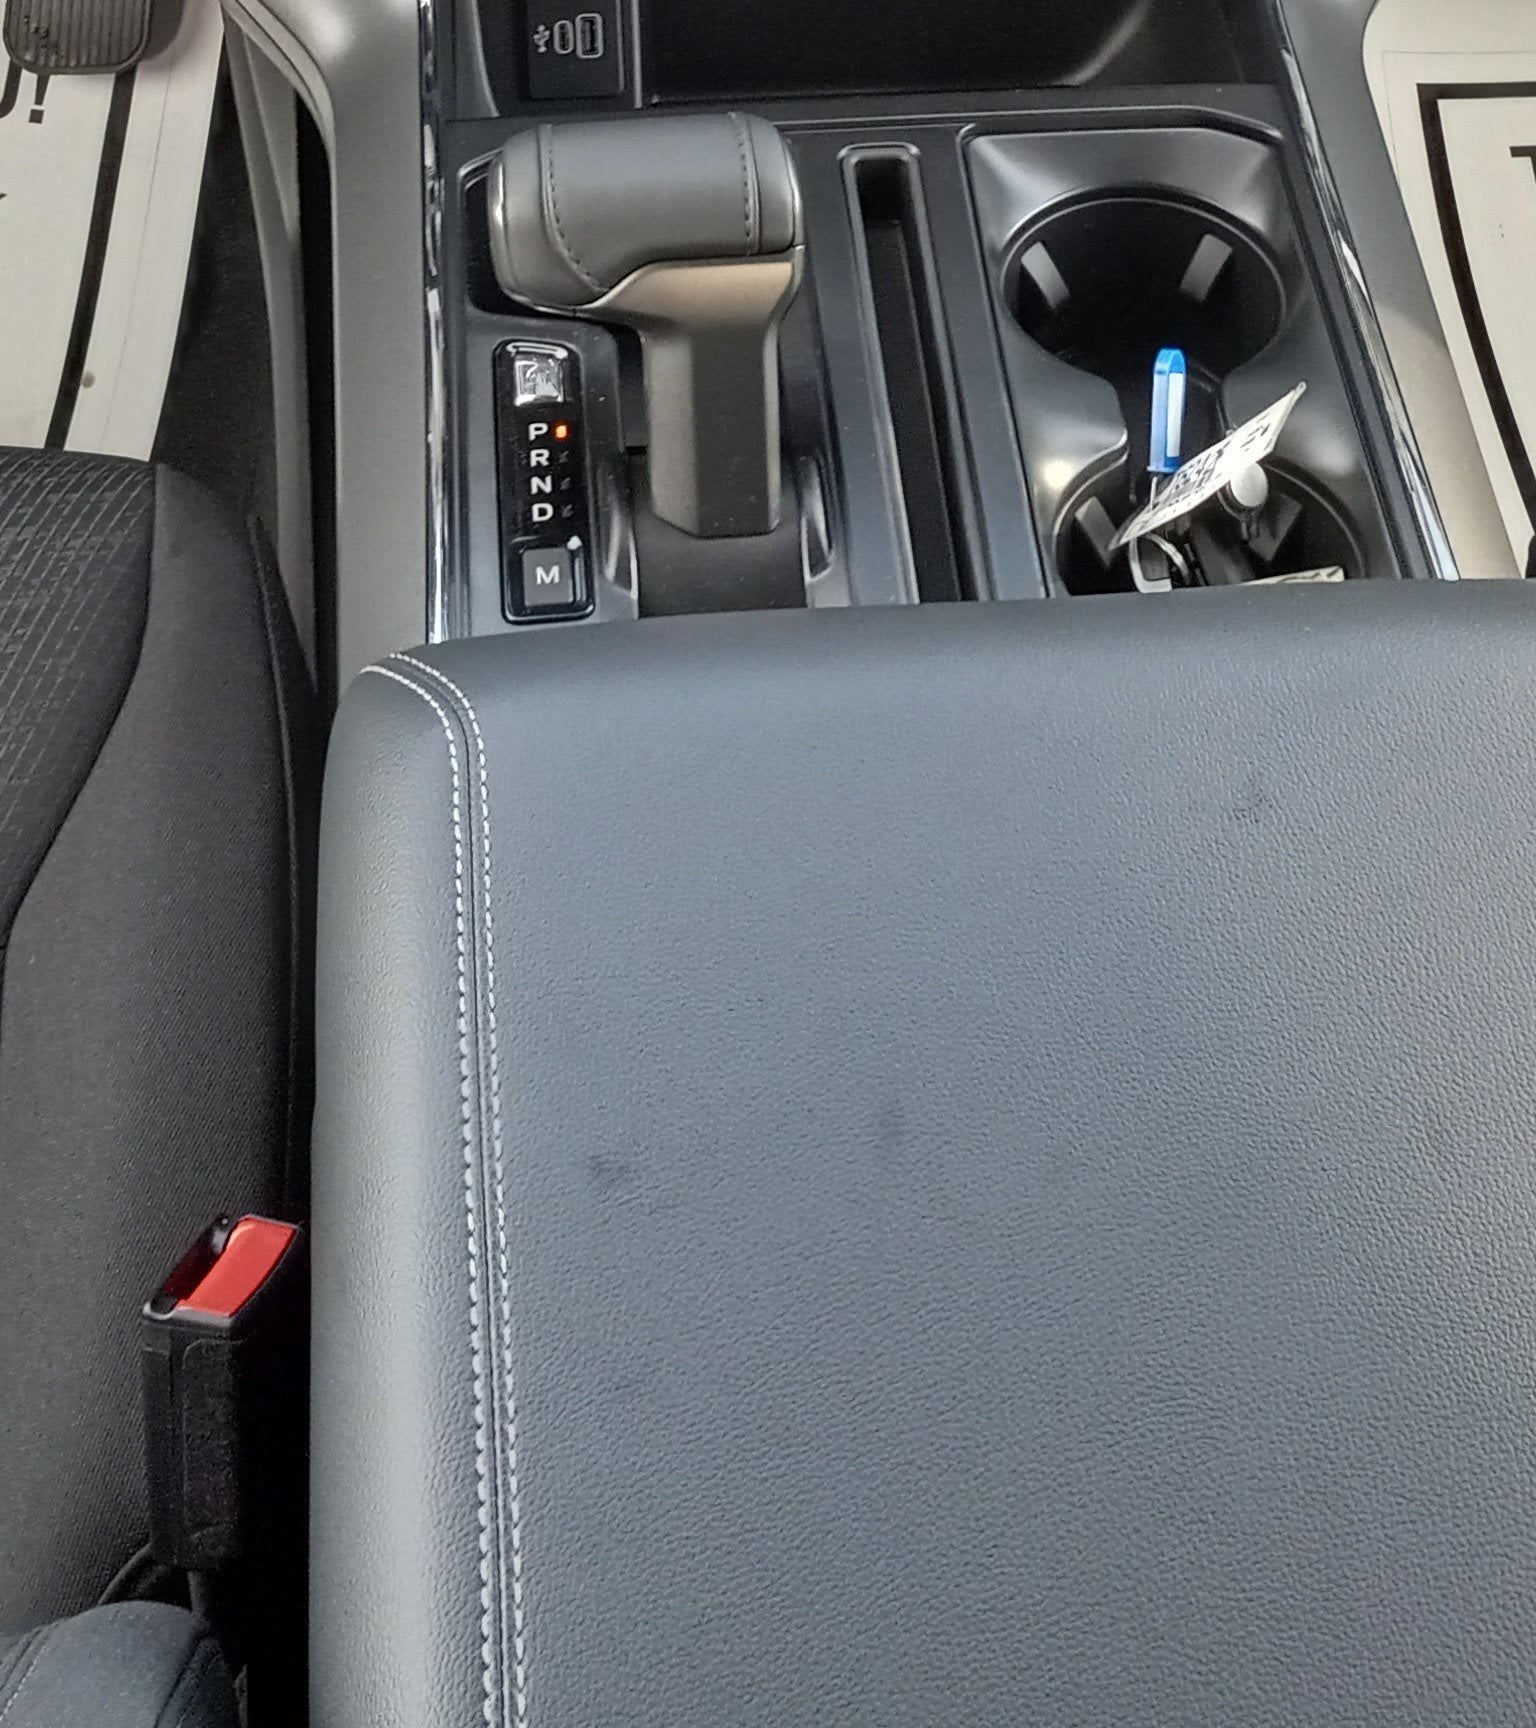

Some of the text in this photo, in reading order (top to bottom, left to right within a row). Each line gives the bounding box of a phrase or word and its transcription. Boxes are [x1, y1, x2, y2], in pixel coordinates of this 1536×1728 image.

[528, 423, 548, 441] P
[530, 449, 550, 467] R
[531, 475, 553, 494] N
[532, 503, 554, 522] D
[535, 565, 560, 585] M
